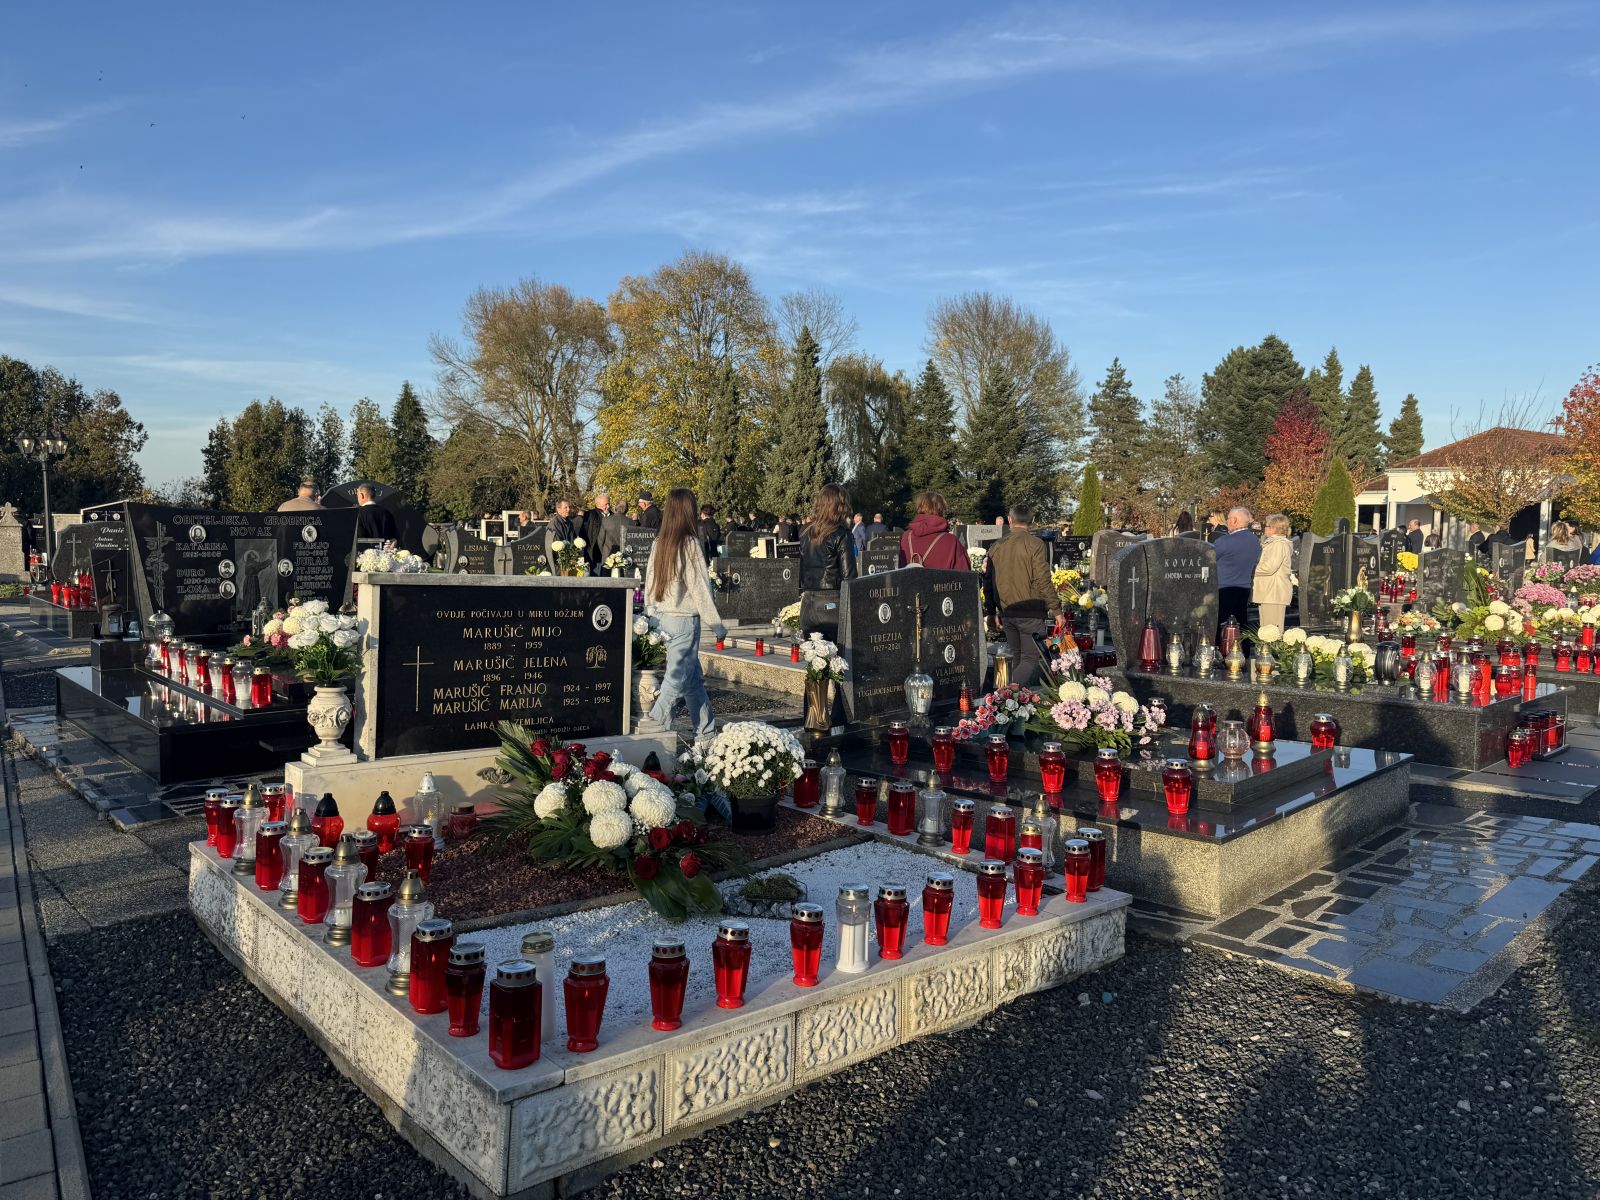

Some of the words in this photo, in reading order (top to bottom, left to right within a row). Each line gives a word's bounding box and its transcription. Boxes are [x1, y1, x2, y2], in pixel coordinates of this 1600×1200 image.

[263, 516, 323, 526] GROBNICA
[230, 526, 272, 536] NOVAK
[176, 542, 229, 551] KATARINA
[292, 542, 330, 550] FRANJO
[869, 586, 900, 598] OBITELJ
[436, 610, 466, 619] OVDJE
[470, 608, 513, 618] POČIVAJU
[518, 610, 524, 618] U
[528, 610, 550, 618] MIRU
[554, 608, 584, 618] BOŽJEM
[462, 624, 524, 639] MARUŠIĆ
[531, 626, 562, 638] MIJO
[932, 625, 966, 636] STANISLAV
[870, 632, 902, 643] TEREZIJA
[484, 642, 502, 650] 1889
[524, 641, 543, 649] 1959
[453, 656, 516, 672] MARUŠIĆ
[522, 656, 568, 669] JELENA
[483, 674, 501, 682] 1896
[524, 672, 543, 680] 1946
[432, 683, 491, 700] MARUŠIĆ
[500, 682, 547, 696] FRANJO
[563, 684, 580, 693] 1924
[594, 682, 612, 691] 1997
[432, 698, 492, 715] MARUŠIĆ
[500, 697, 542, 710] MARIJA
[562, 698, 580, 706] 1925
[594, 696, 611, 704] 1996
[464, 722, 495, 731] LAHKA
[514, 716, 554, 726] ZEMLJICA
